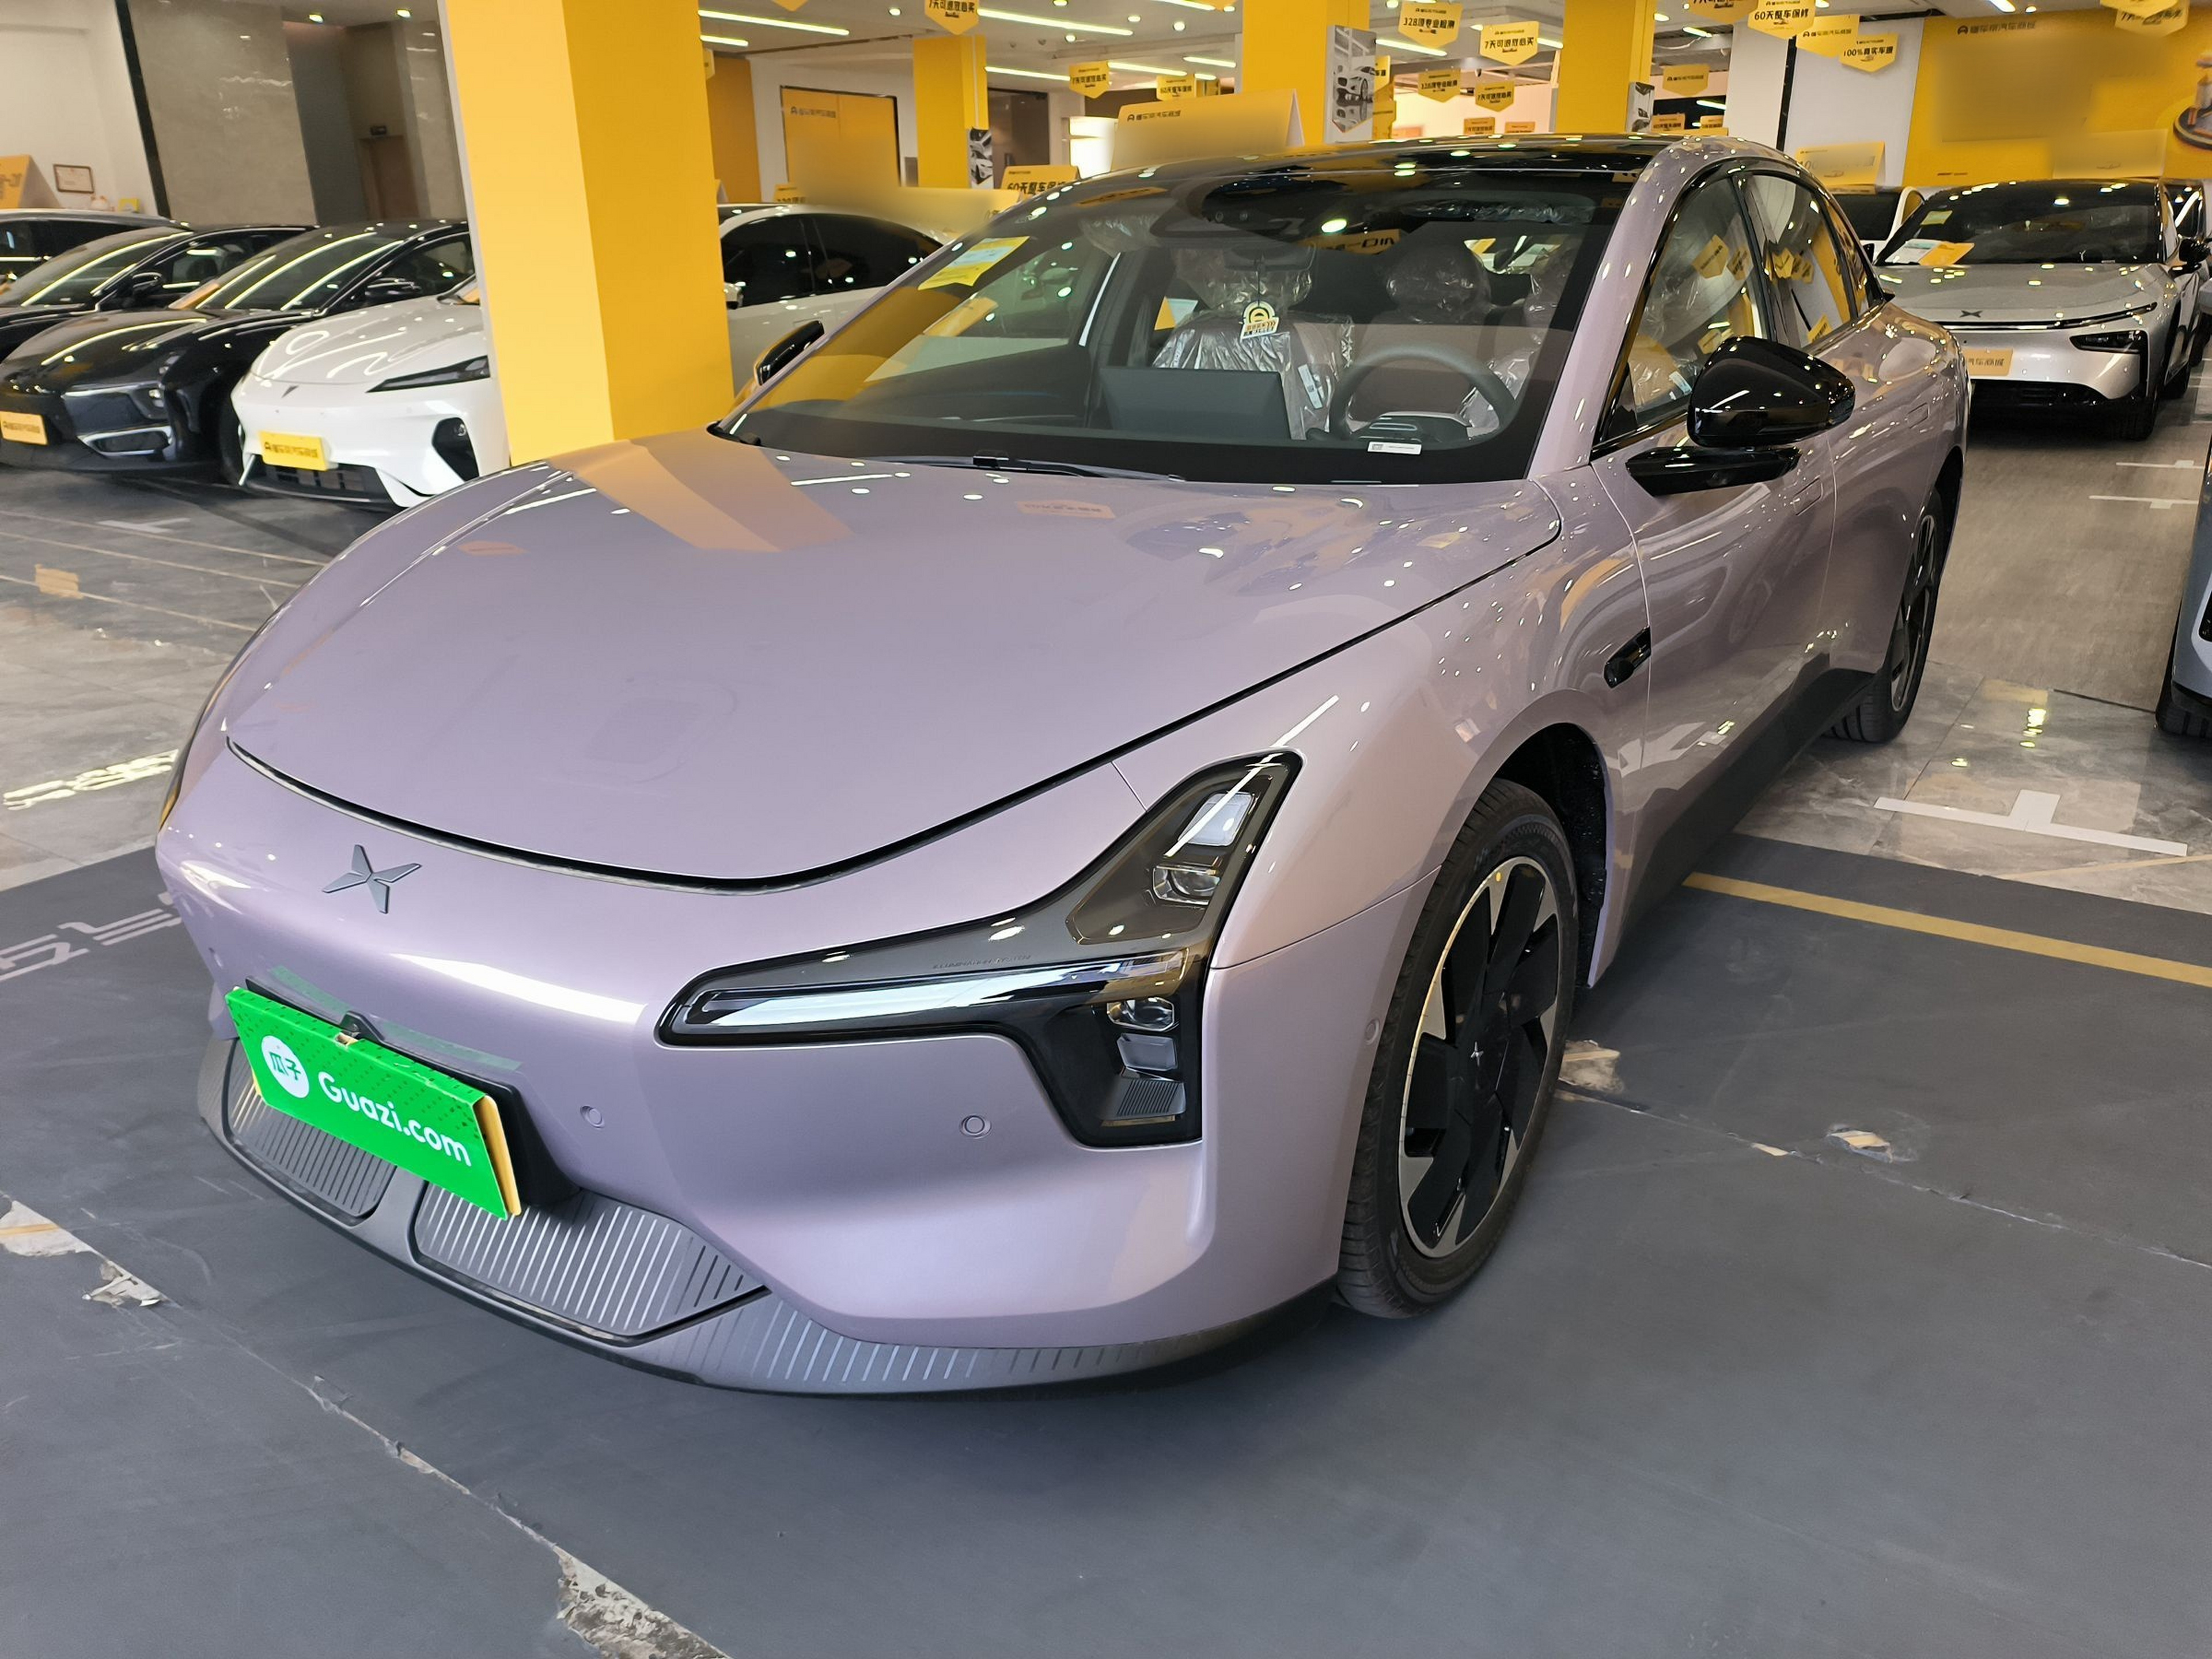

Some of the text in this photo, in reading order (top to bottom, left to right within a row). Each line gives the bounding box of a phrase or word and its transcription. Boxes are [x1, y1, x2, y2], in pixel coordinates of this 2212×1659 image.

[1754, 8, 1809, 20] 60天整车保修
[269, 1052, 301, 1081] 瓜子
[318, 1071, 472, 1167] Guazi.com
